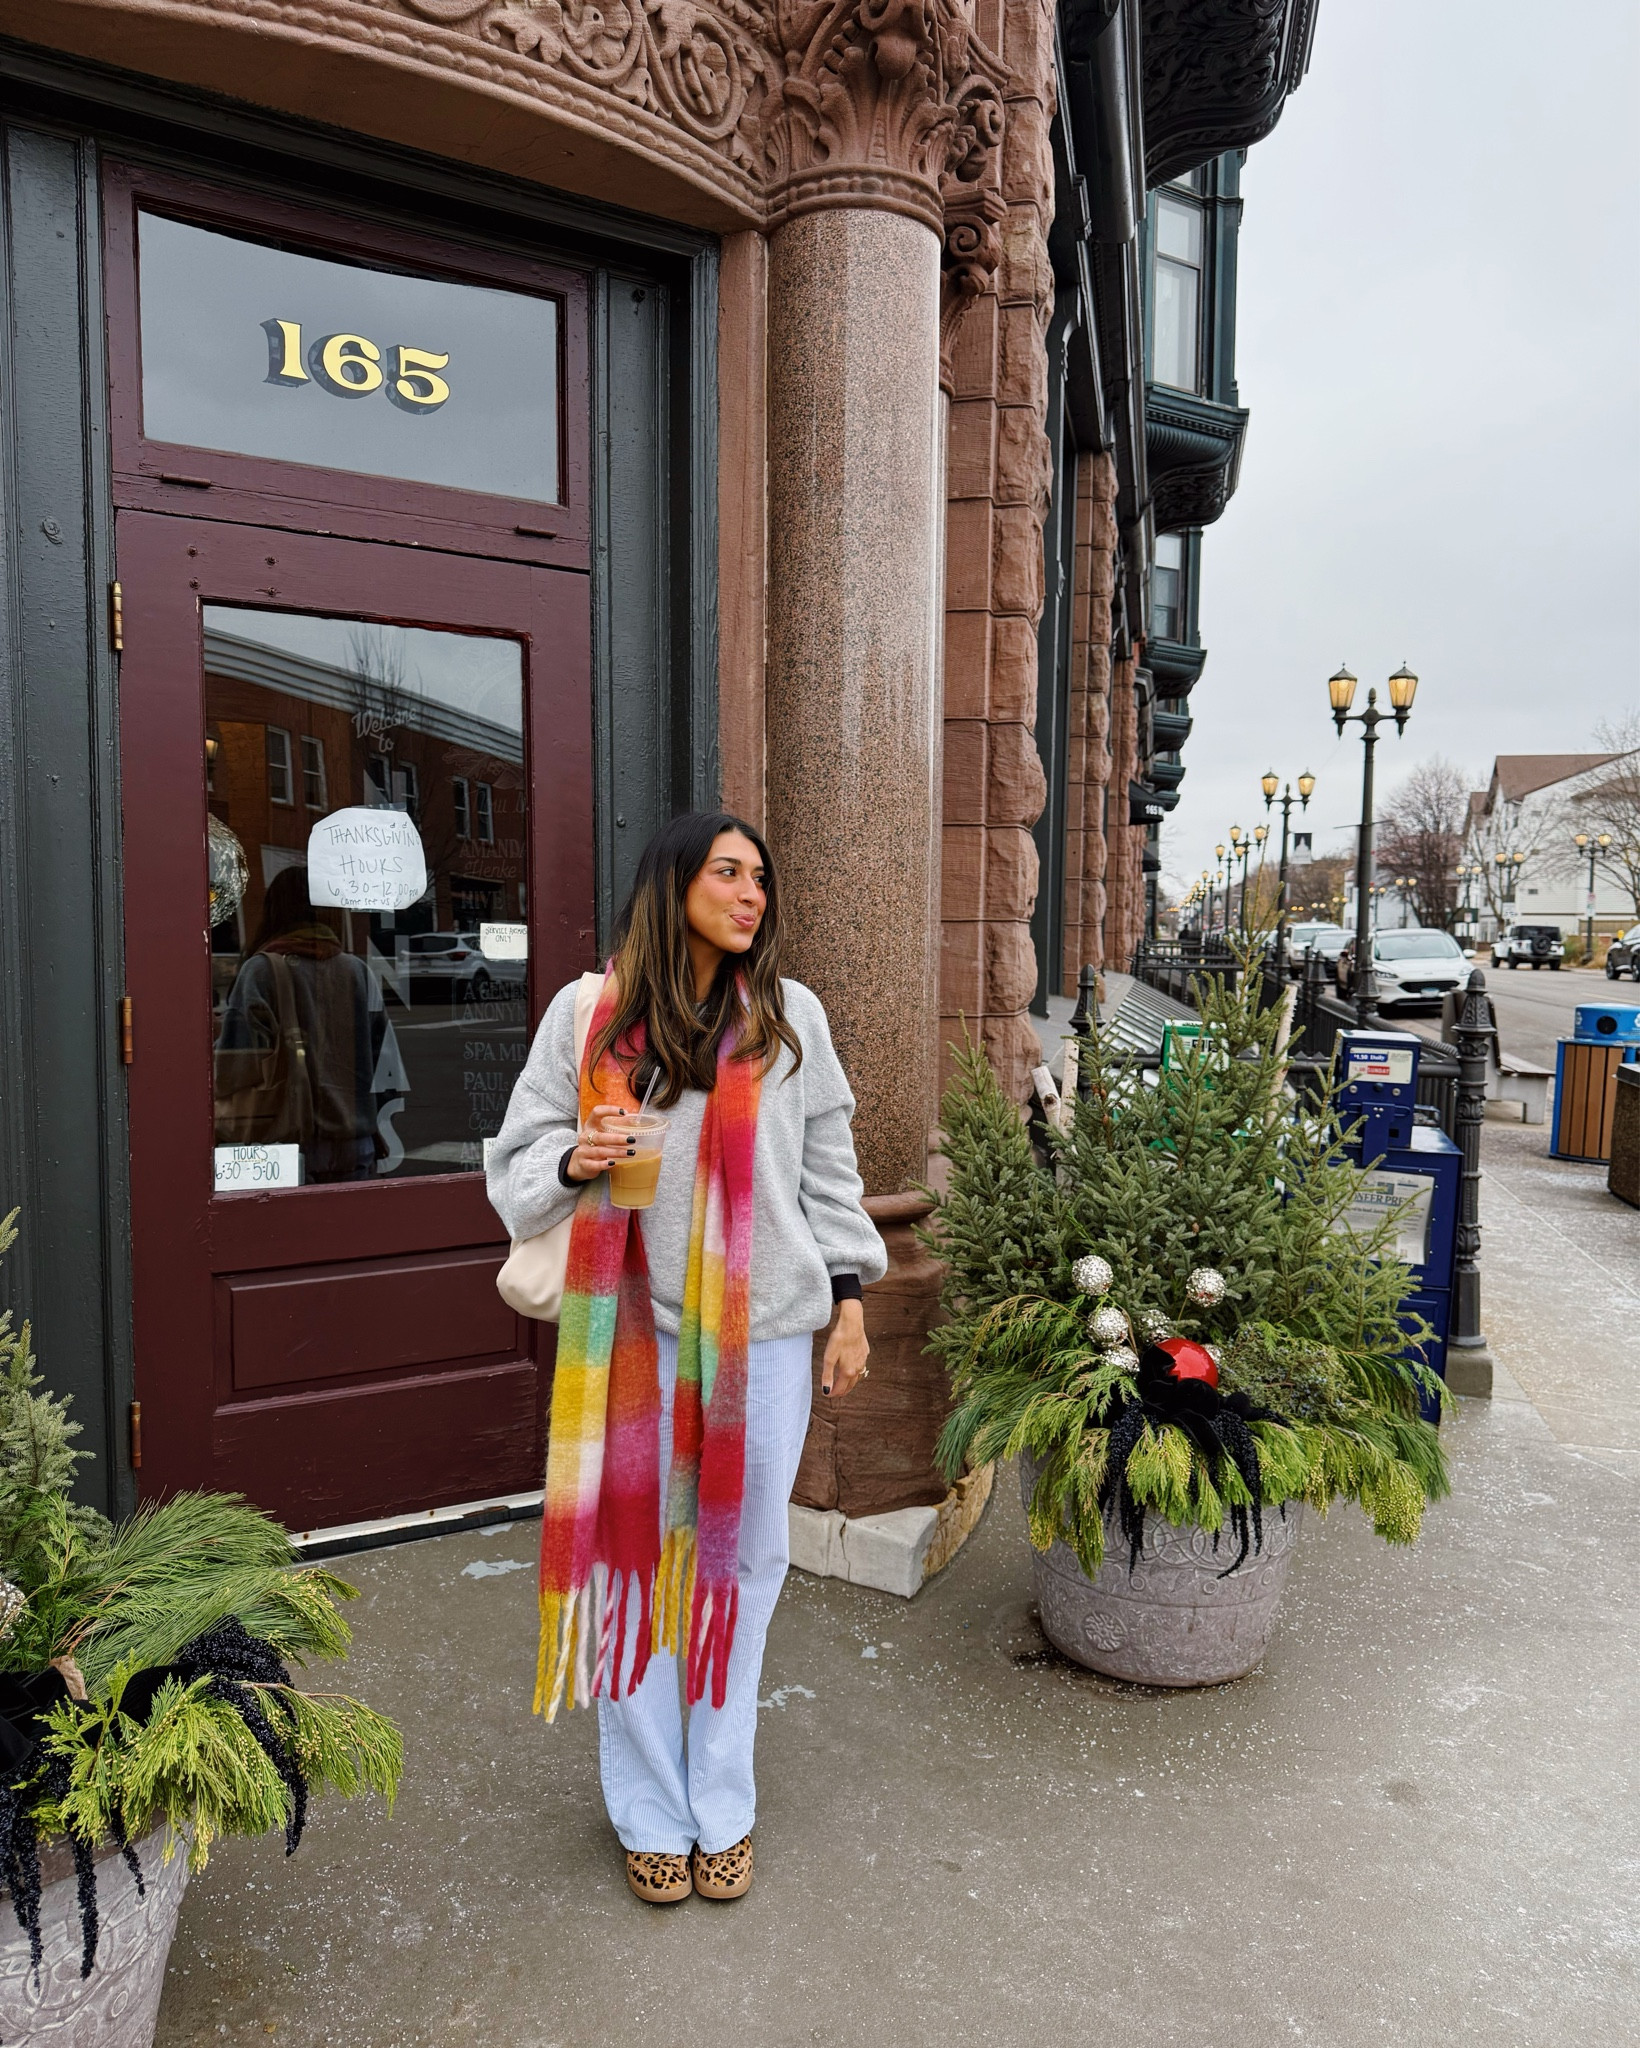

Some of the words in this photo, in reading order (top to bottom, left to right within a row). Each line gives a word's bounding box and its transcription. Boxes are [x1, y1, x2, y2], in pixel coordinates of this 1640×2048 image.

[261, 317, 451, 415] 165
[351, 708, 417, 739] Welcome
[370, 733, 394, 753] to
[463, 859, 517, 879] Henke
[461, 890, 504, 910] HIVE
[495, 935, 511, 943] ONLY
[464, 1041, 496, 1061] SPA
[464, 1071, 509, 1091] PAUL
[469, 1092, 507, 1111] TINA
[233, 1146, 268, 1160] HOURS
[215, 1162, 241, 1180] 6:30
[253, 1161, 280, 1181] 5:00
